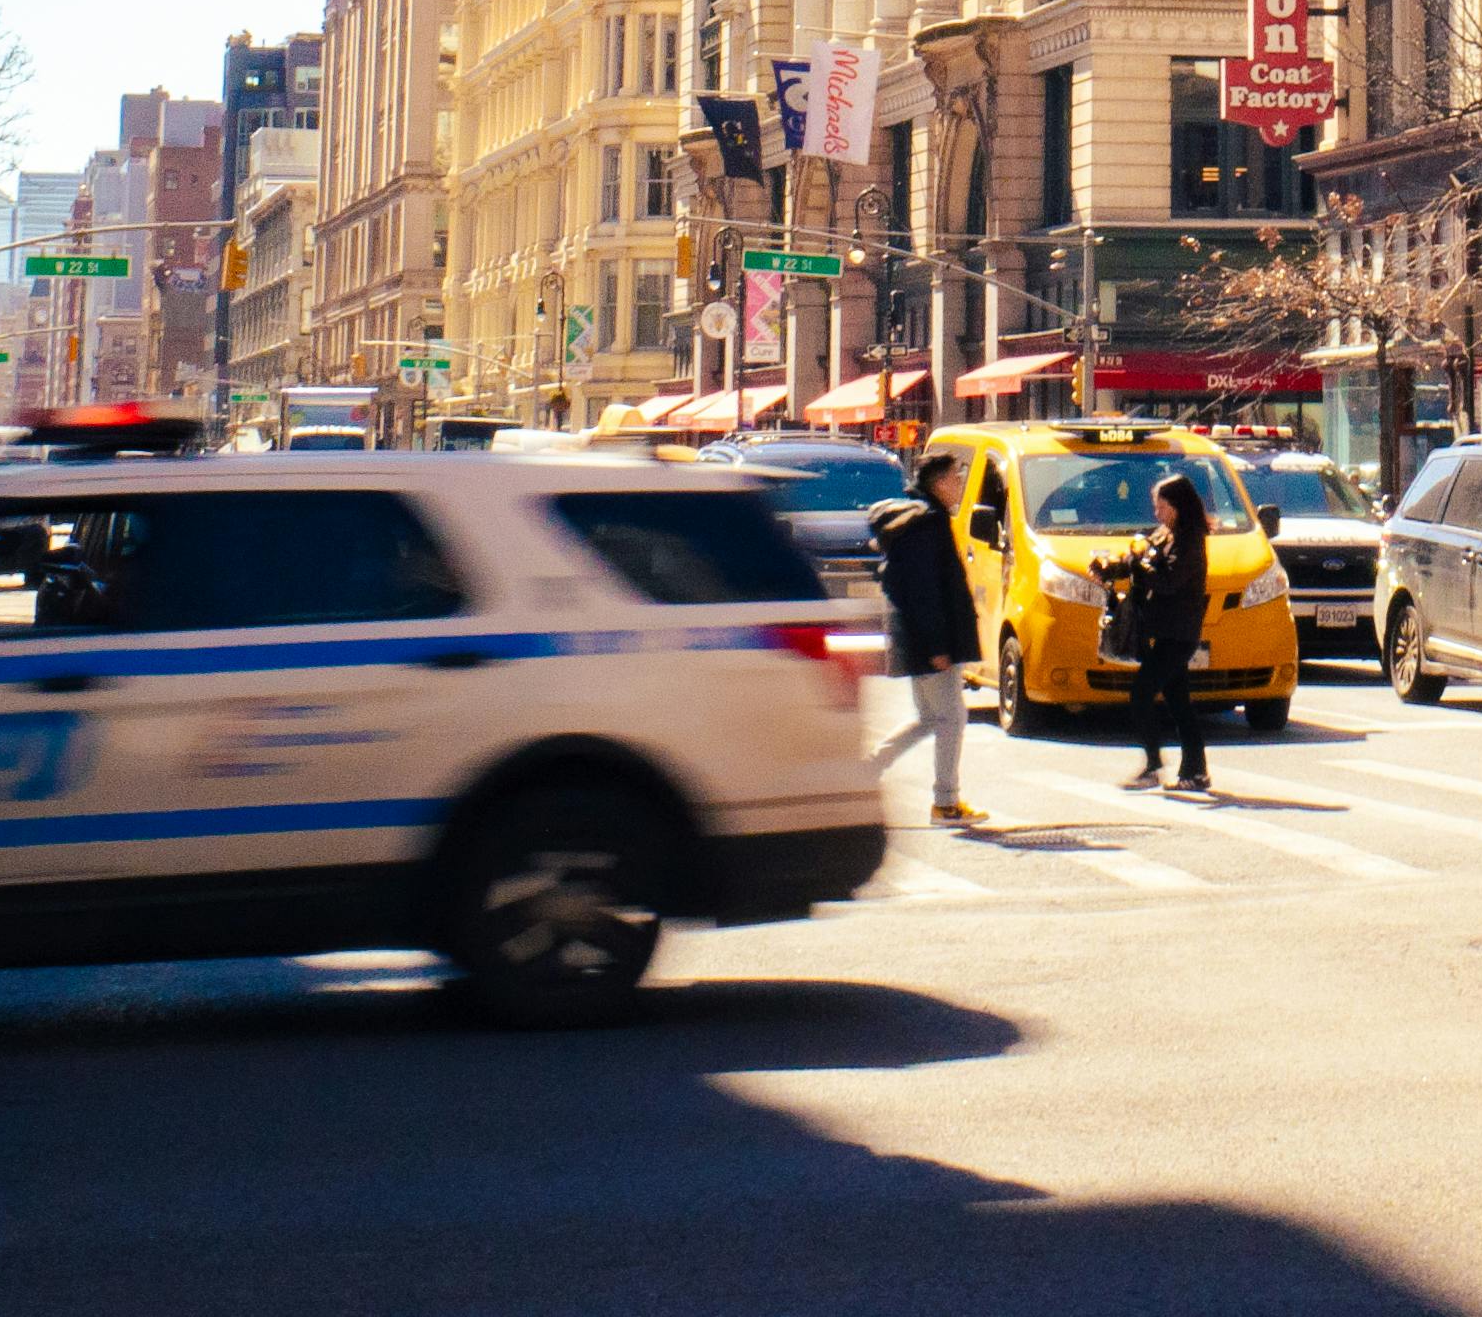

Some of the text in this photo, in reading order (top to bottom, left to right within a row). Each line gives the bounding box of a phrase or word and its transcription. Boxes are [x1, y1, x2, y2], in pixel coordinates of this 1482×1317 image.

[1250, 63, 1312, 85] Coat
[822, 50, 860, 155] Michaels
[1229, 86, 1333, 114] Factory
[1207, 373, 1238, 389] DXL
